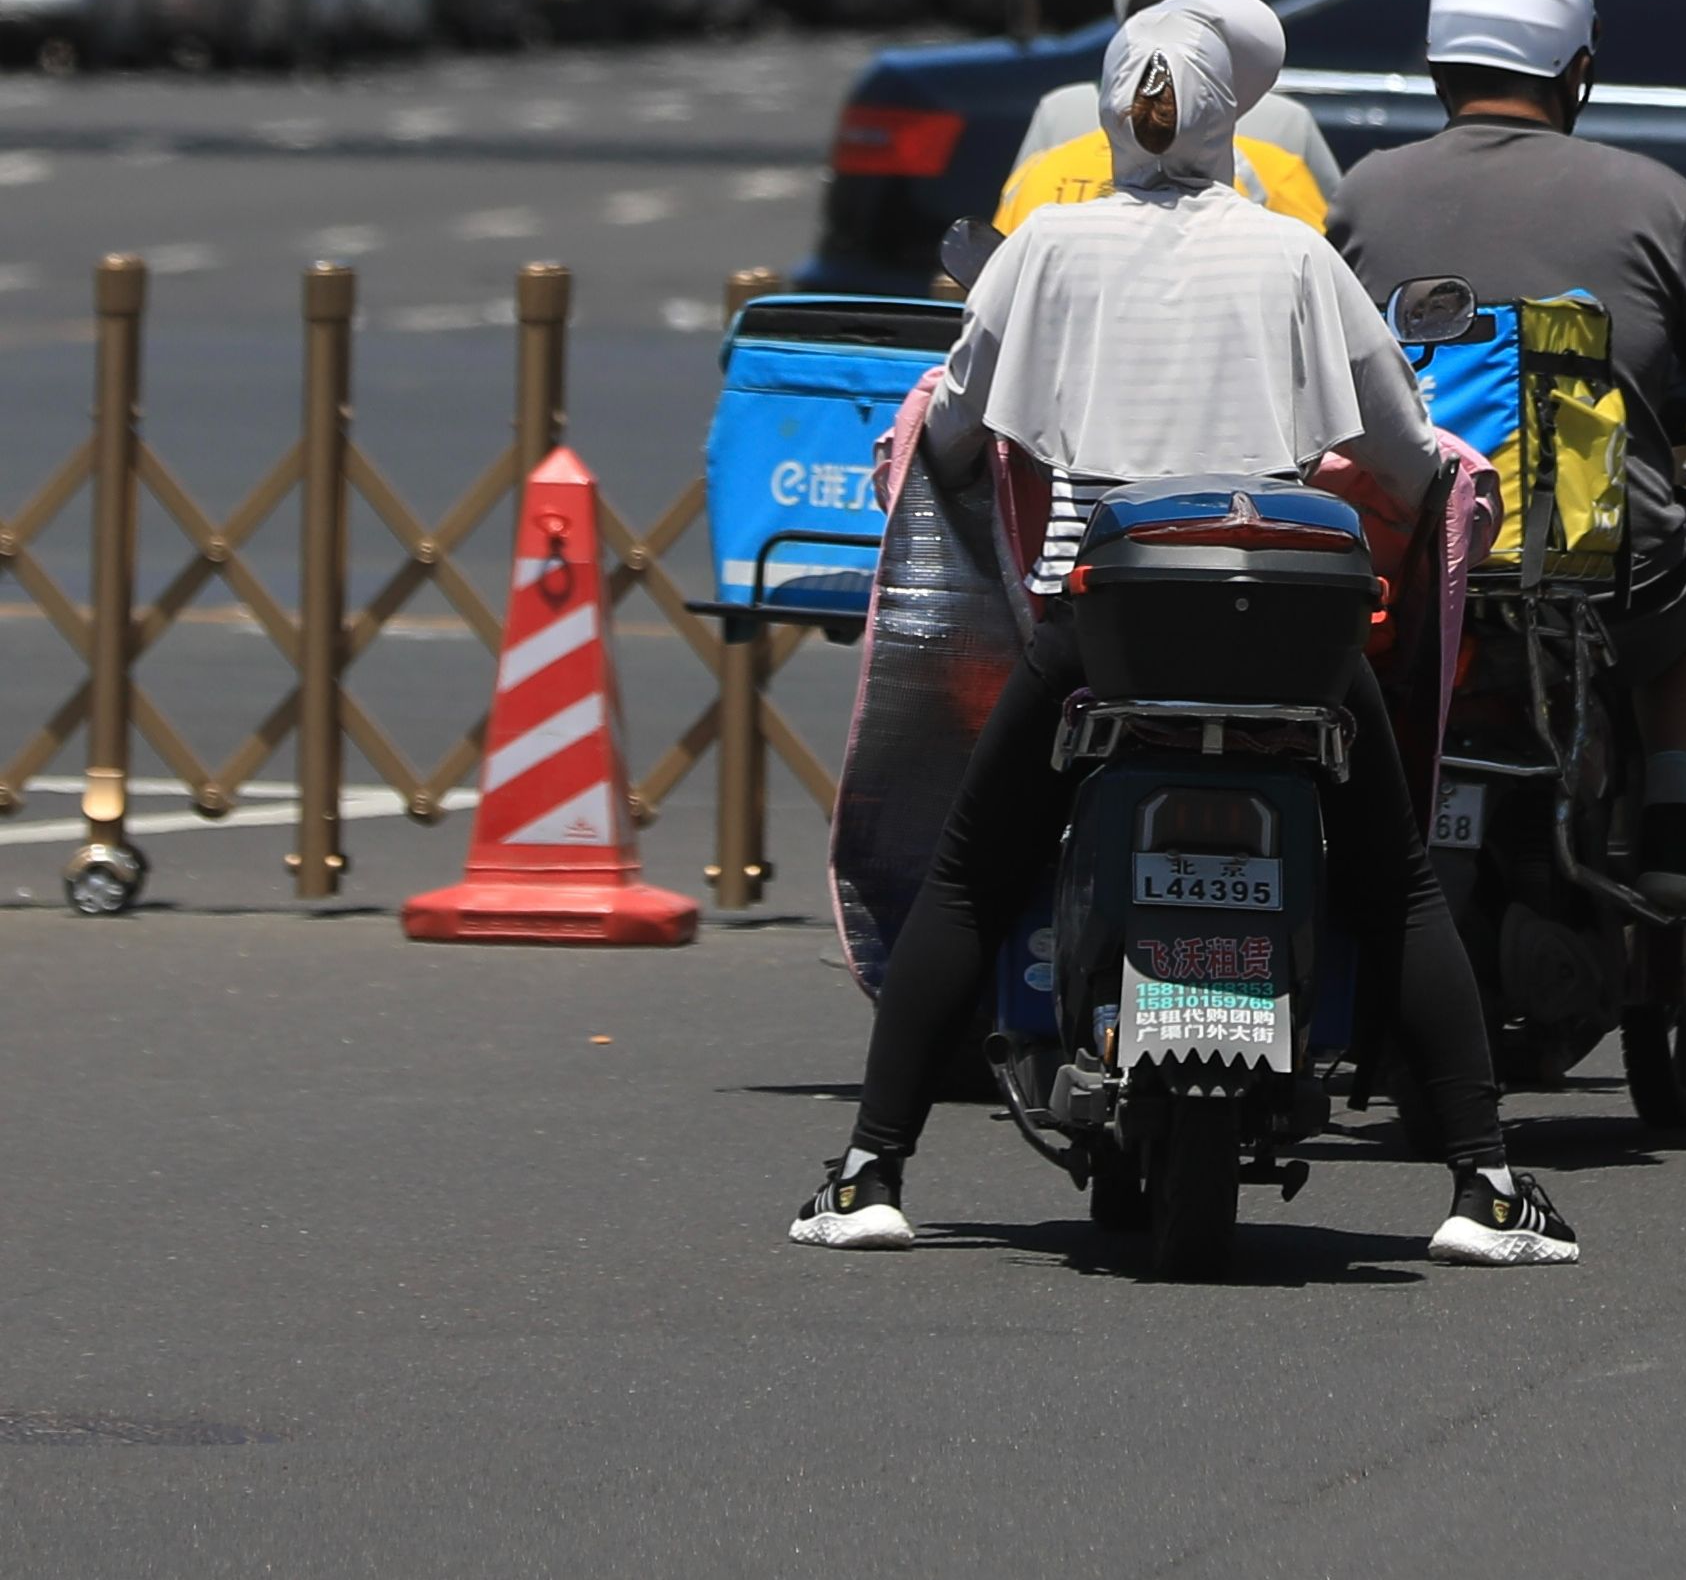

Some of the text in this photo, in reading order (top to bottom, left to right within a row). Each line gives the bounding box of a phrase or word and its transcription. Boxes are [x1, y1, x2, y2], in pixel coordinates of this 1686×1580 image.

[1171, 859, 1247, 877] 北京
[1144, 876, 1271, 904] L44395
[1137, 936, 1273, 979] 飞沃租赁
[1136, 995, 1274, 1010] 15810159765
[1136, 1025, 1275, 1043] 广渠门外大街
